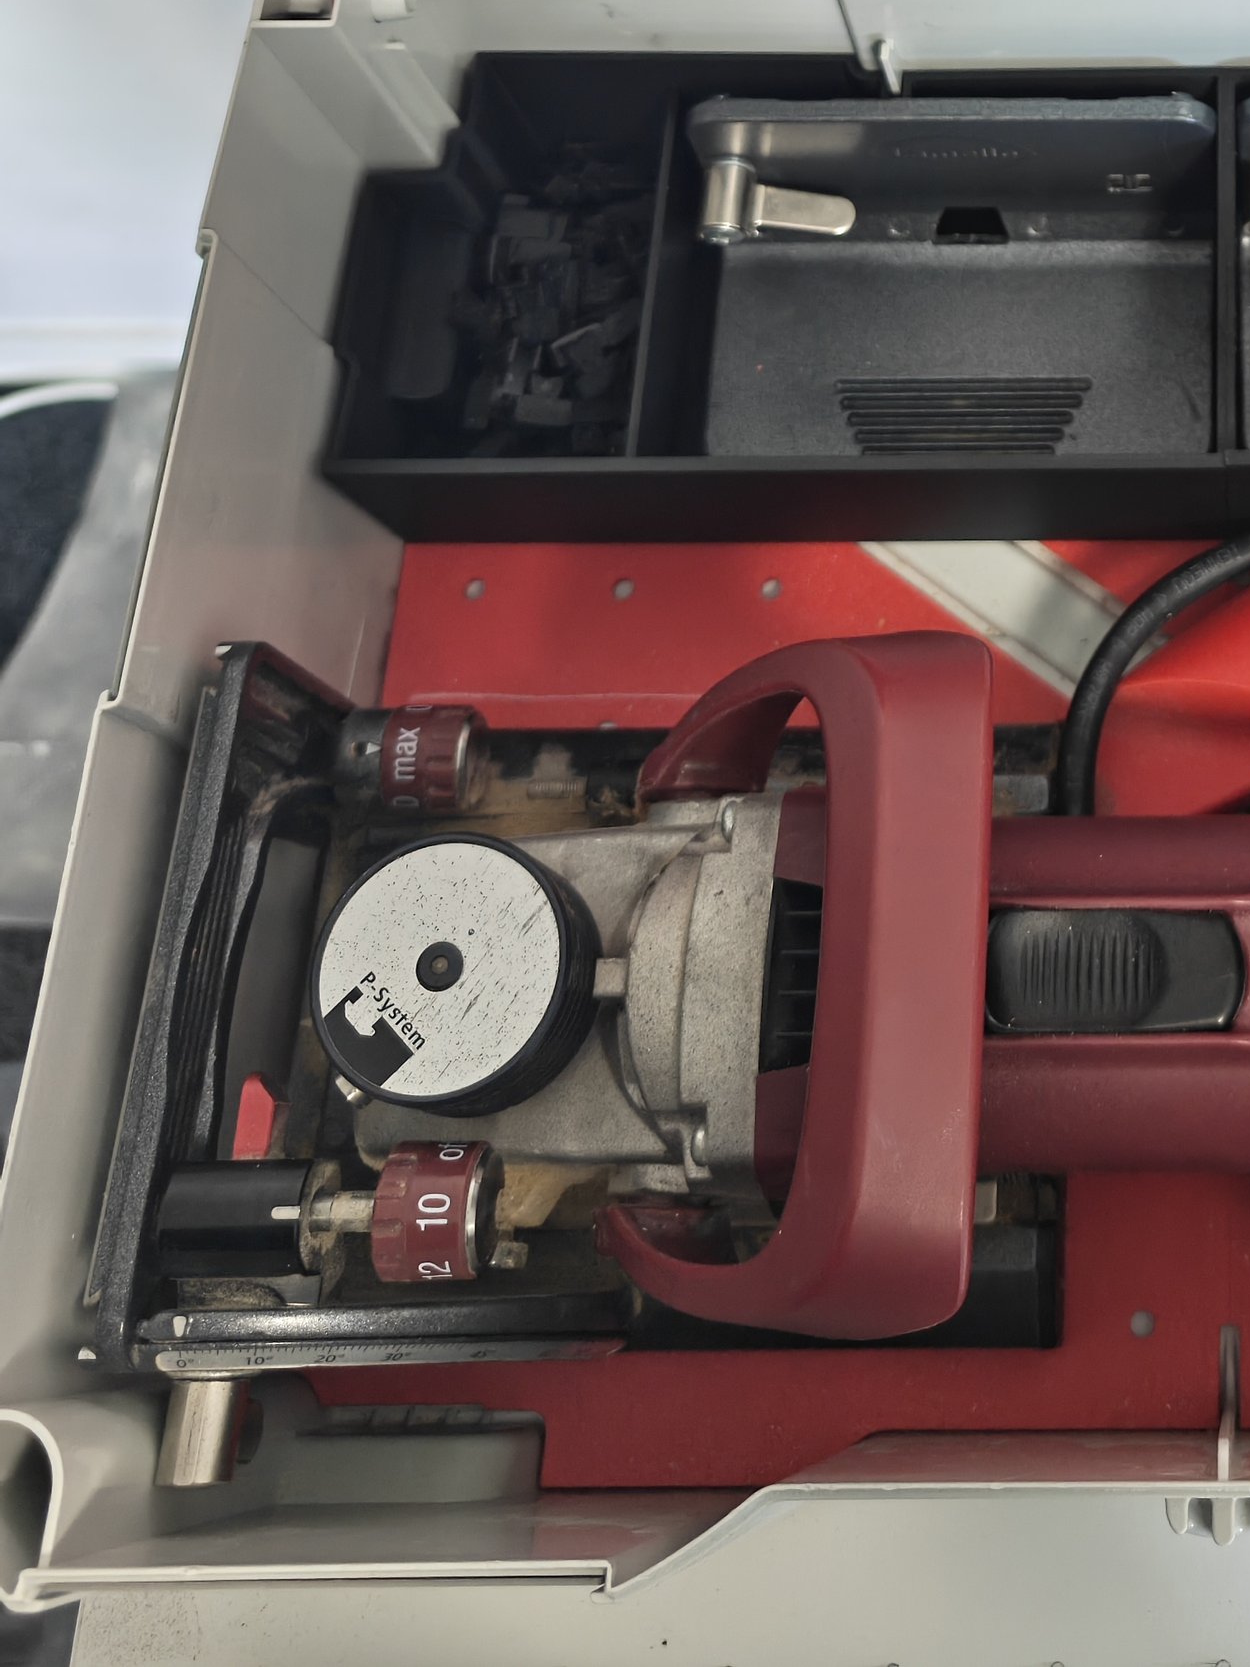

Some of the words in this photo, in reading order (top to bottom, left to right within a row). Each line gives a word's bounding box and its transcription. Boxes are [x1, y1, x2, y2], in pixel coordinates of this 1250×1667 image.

[395, 727, 421, 780] max
[360, 971, 426, 1050] P-System
[416, 1193, 451, 1232] 10
